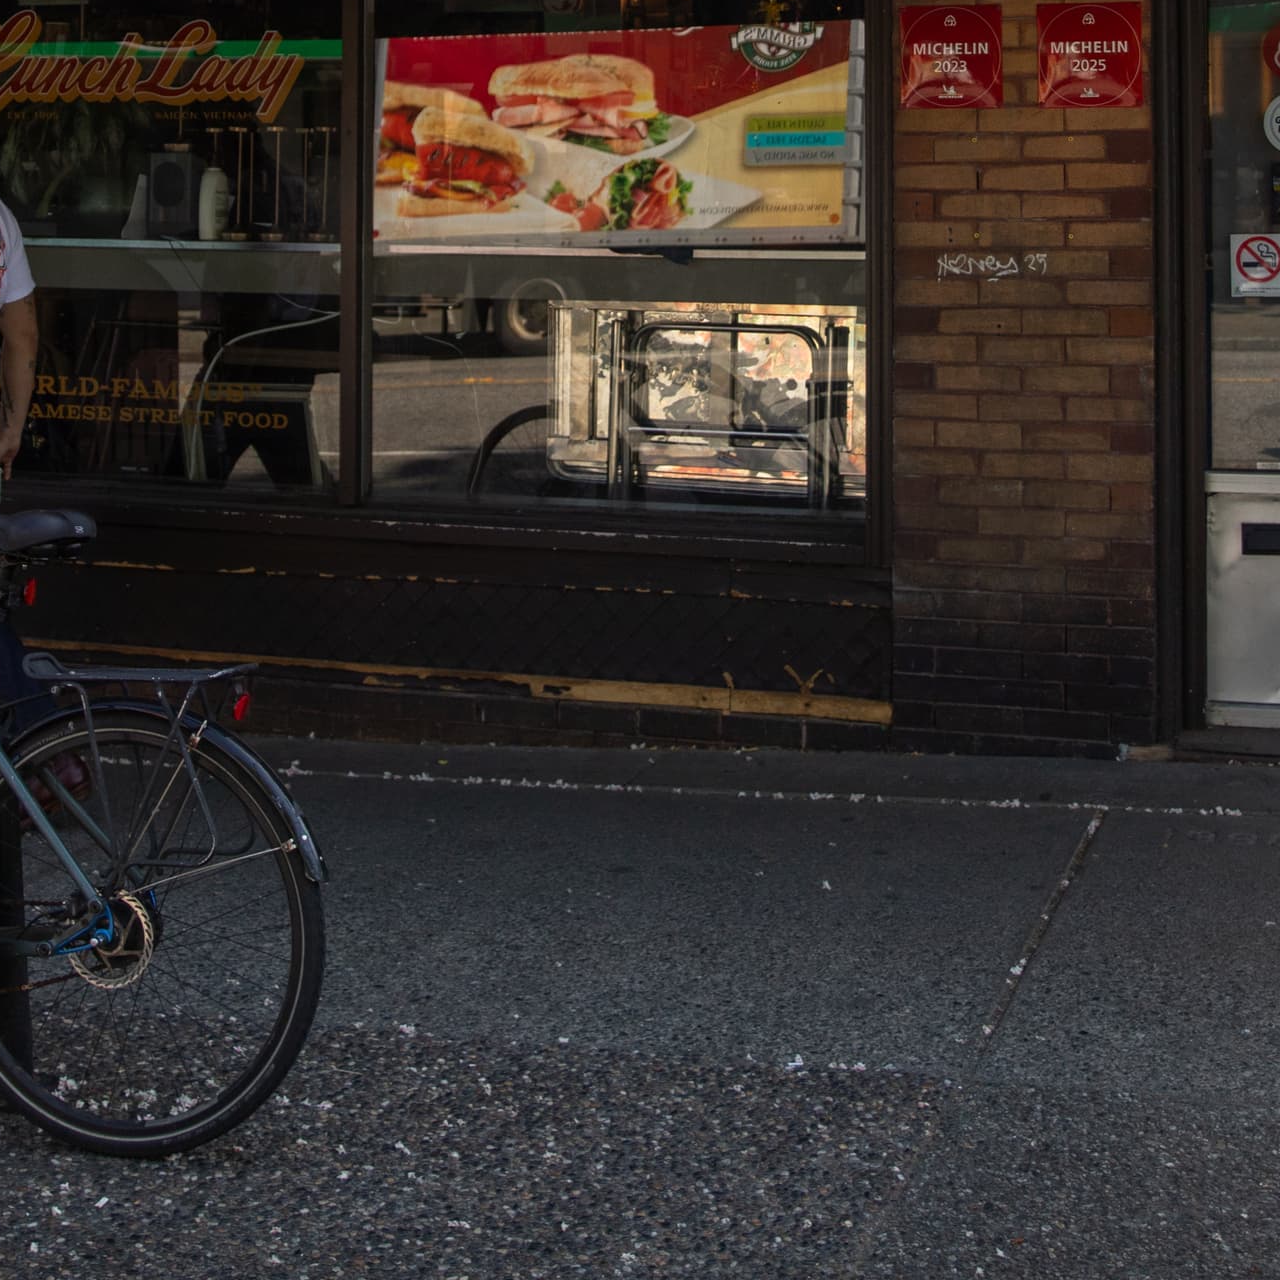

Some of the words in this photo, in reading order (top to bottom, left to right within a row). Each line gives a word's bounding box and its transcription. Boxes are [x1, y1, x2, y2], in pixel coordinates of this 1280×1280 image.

[912, 41, 990, 56] MICHELIN
[1050, 40, 1129, 55] MICHELIN
[133, 19, 306, 123] Lady
[933, 60, 968, 74] 2023
[1071, 58, 1107, 73] 2025
[223, 410, 289, 431] FOOD
